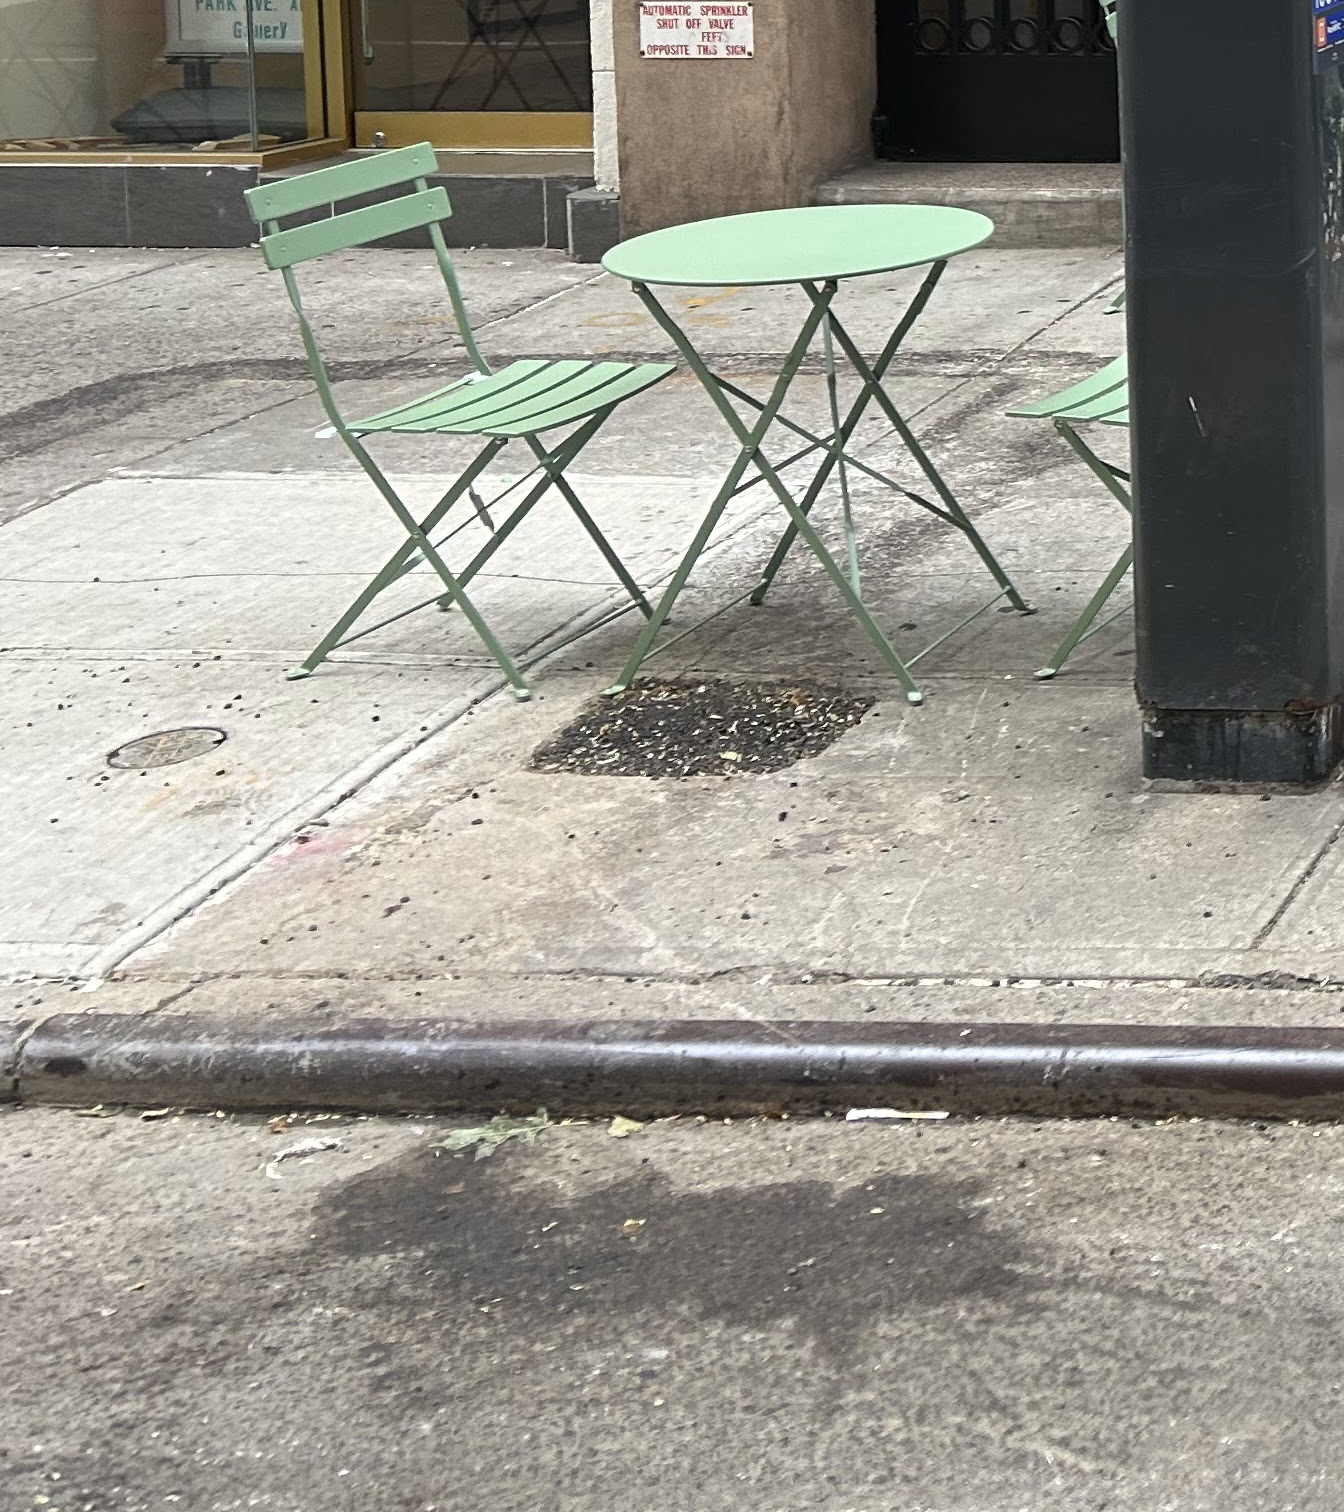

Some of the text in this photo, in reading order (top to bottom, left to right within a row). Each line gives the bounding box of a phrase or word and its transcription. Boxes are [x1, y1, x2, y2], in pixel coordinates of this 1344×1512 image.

[642, 5, 748, 17] AUTOMATIC SPRINKLER
[657, 18, 734, 30] SHUT OFF VALVE
[702, 31, 723, 42] FEET
[647, 44, 746, 56] OPPOSITE THIS SIGN
